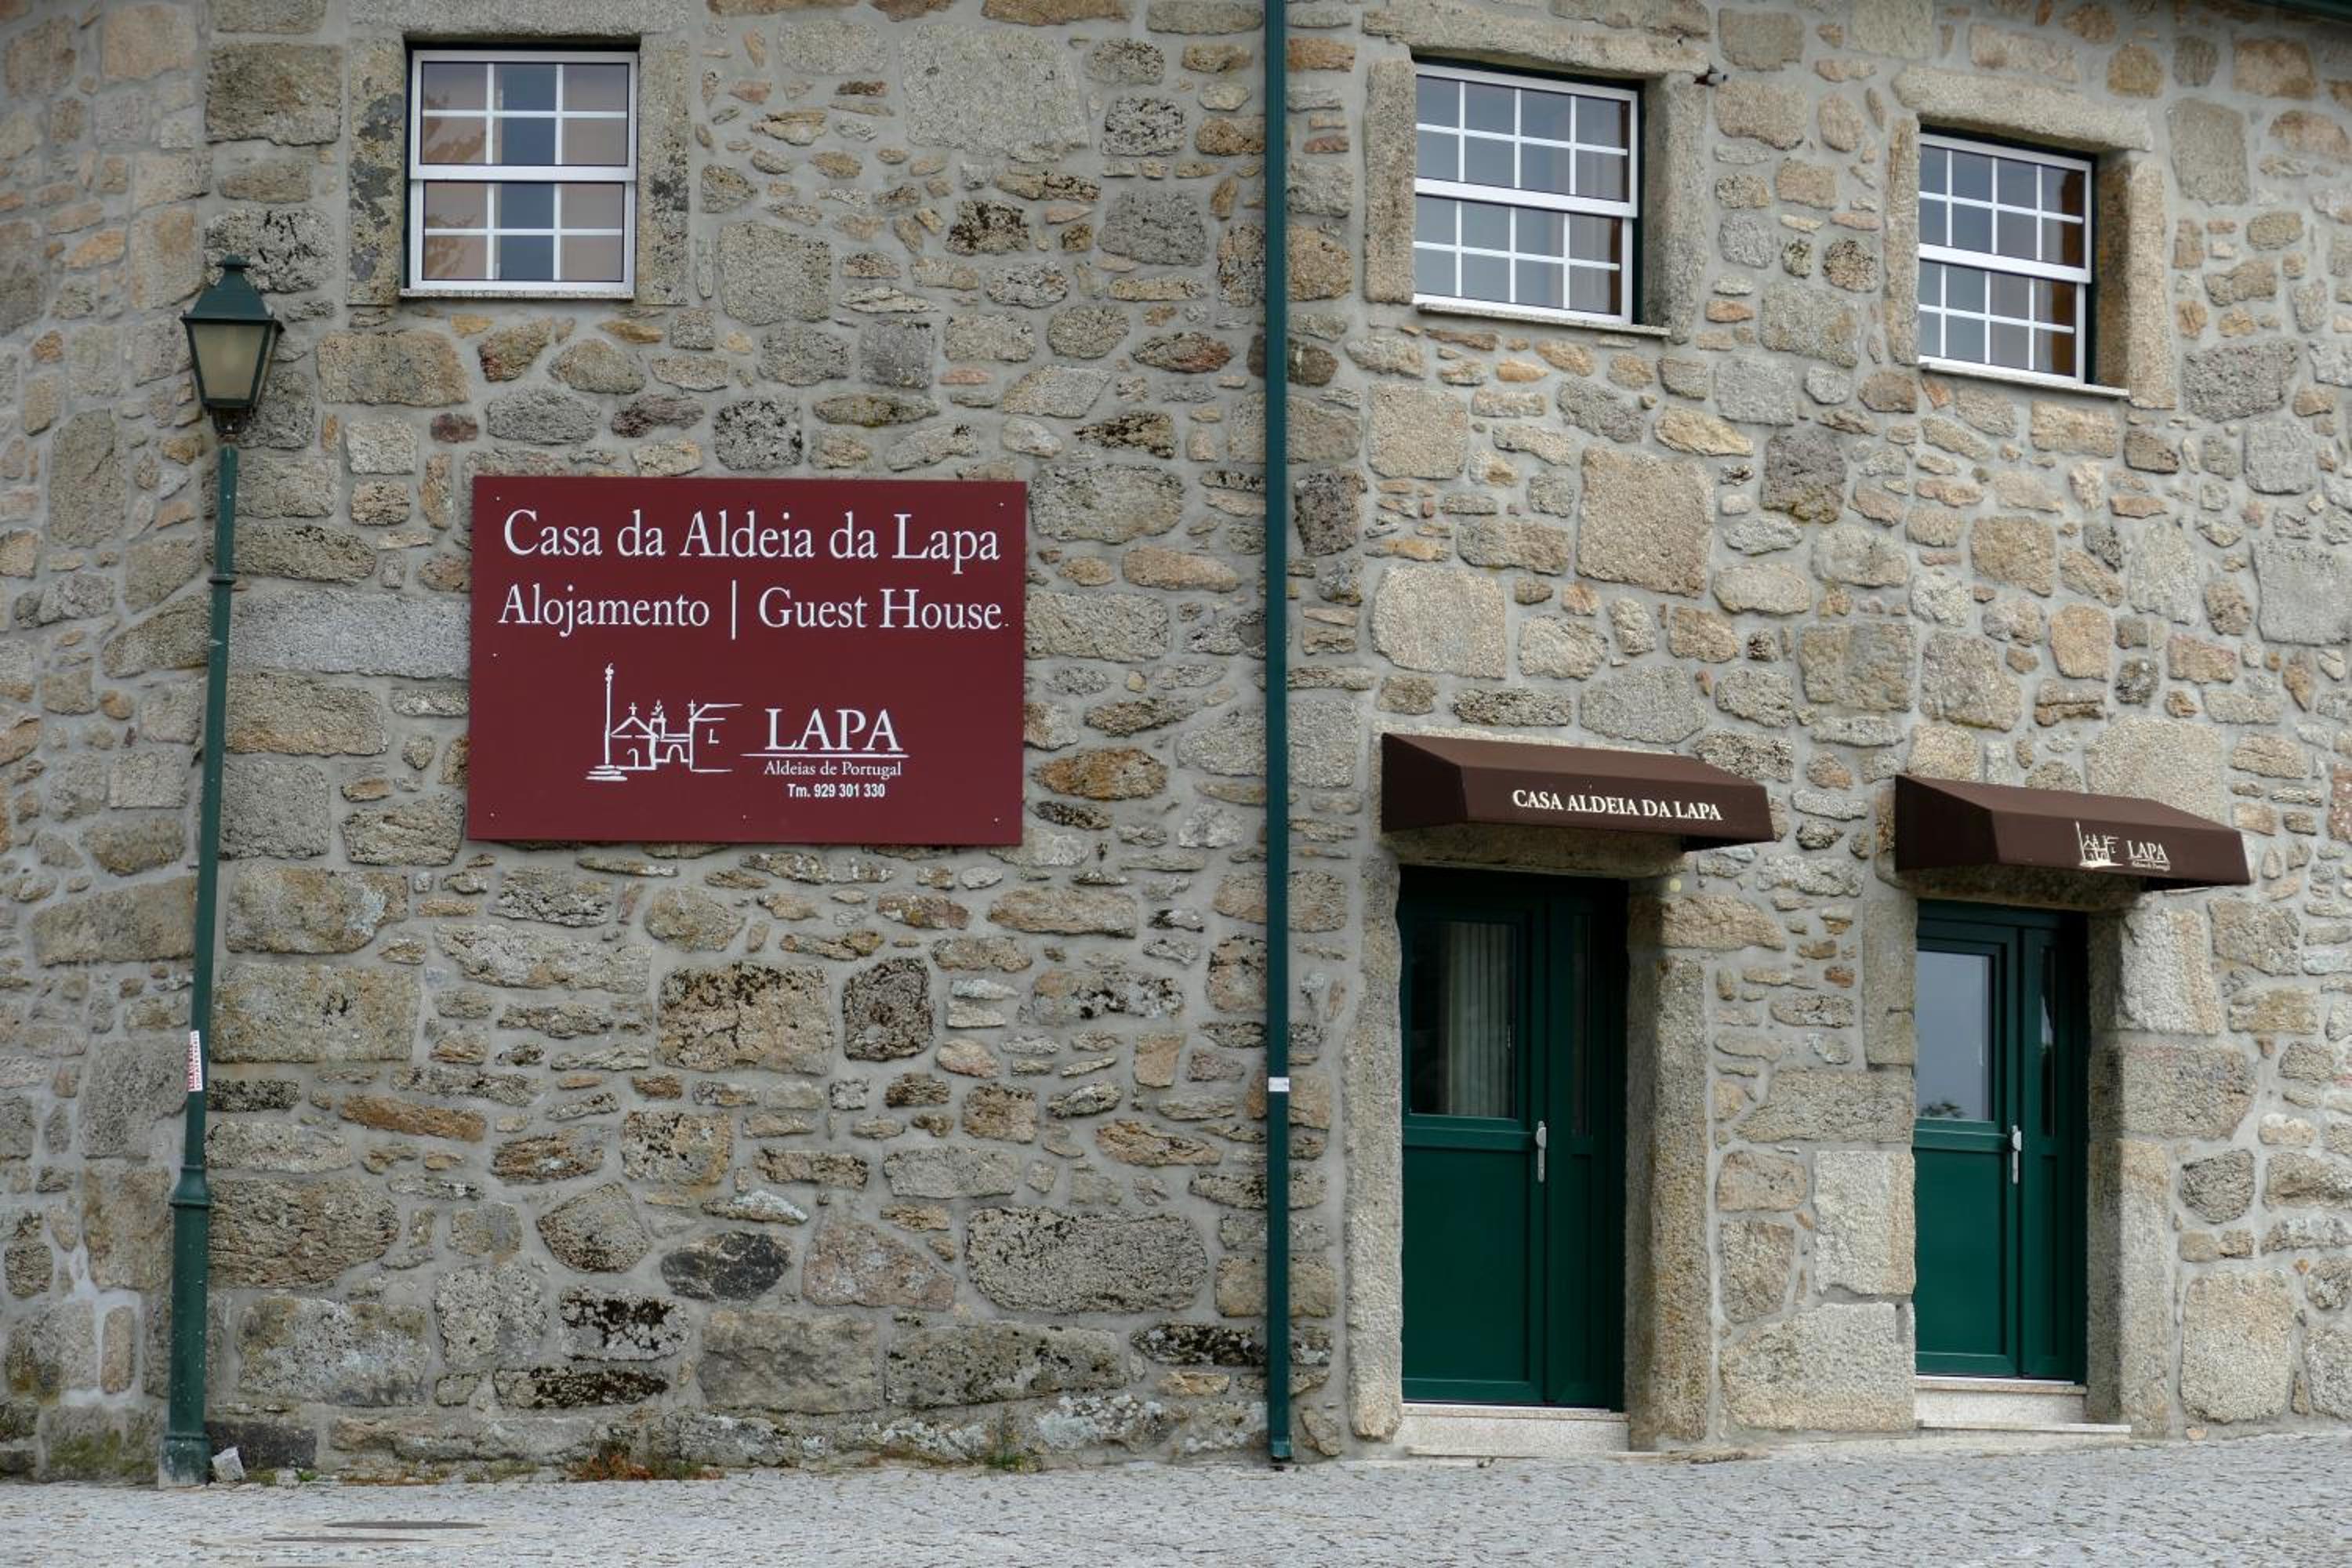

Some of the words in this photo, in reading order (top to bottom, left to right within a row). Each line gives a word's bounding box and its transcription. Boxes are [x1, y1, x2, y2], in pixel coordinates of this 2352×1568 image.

[504, 509, 602, 556] Casa
[617, 509, 666, 557] da
[679, 510, 816, 558] Aldeia
[829, 511, 879, 559] da
[891, 514, 1000, 574] Lapa
[498, 583, 710, 637] Alojamento
[758, 586, 868, 628] Guest
[879, 588, 1001, 630] House
[764, 708, 904, 752] LAPA
[764, 760, 816, 775] Aldeias
[819, 760, 837, 775] de
[841, 761, 902, 779] Portugal
[787, 784, 811, 798] Tm.
[813, 784, 837, 798] 929
[838, 783, 860, 798] 301
[863, 783, 885, 798] 330
[1512, 789, 1563, 810] CASA
[1567, 794, 1640, 815] ALDEIA
[1642, 799, 1671, 818] DA
[1673, 801, 1722, 821] LAPA
[2126, 840, 2170, 863] LAPA
